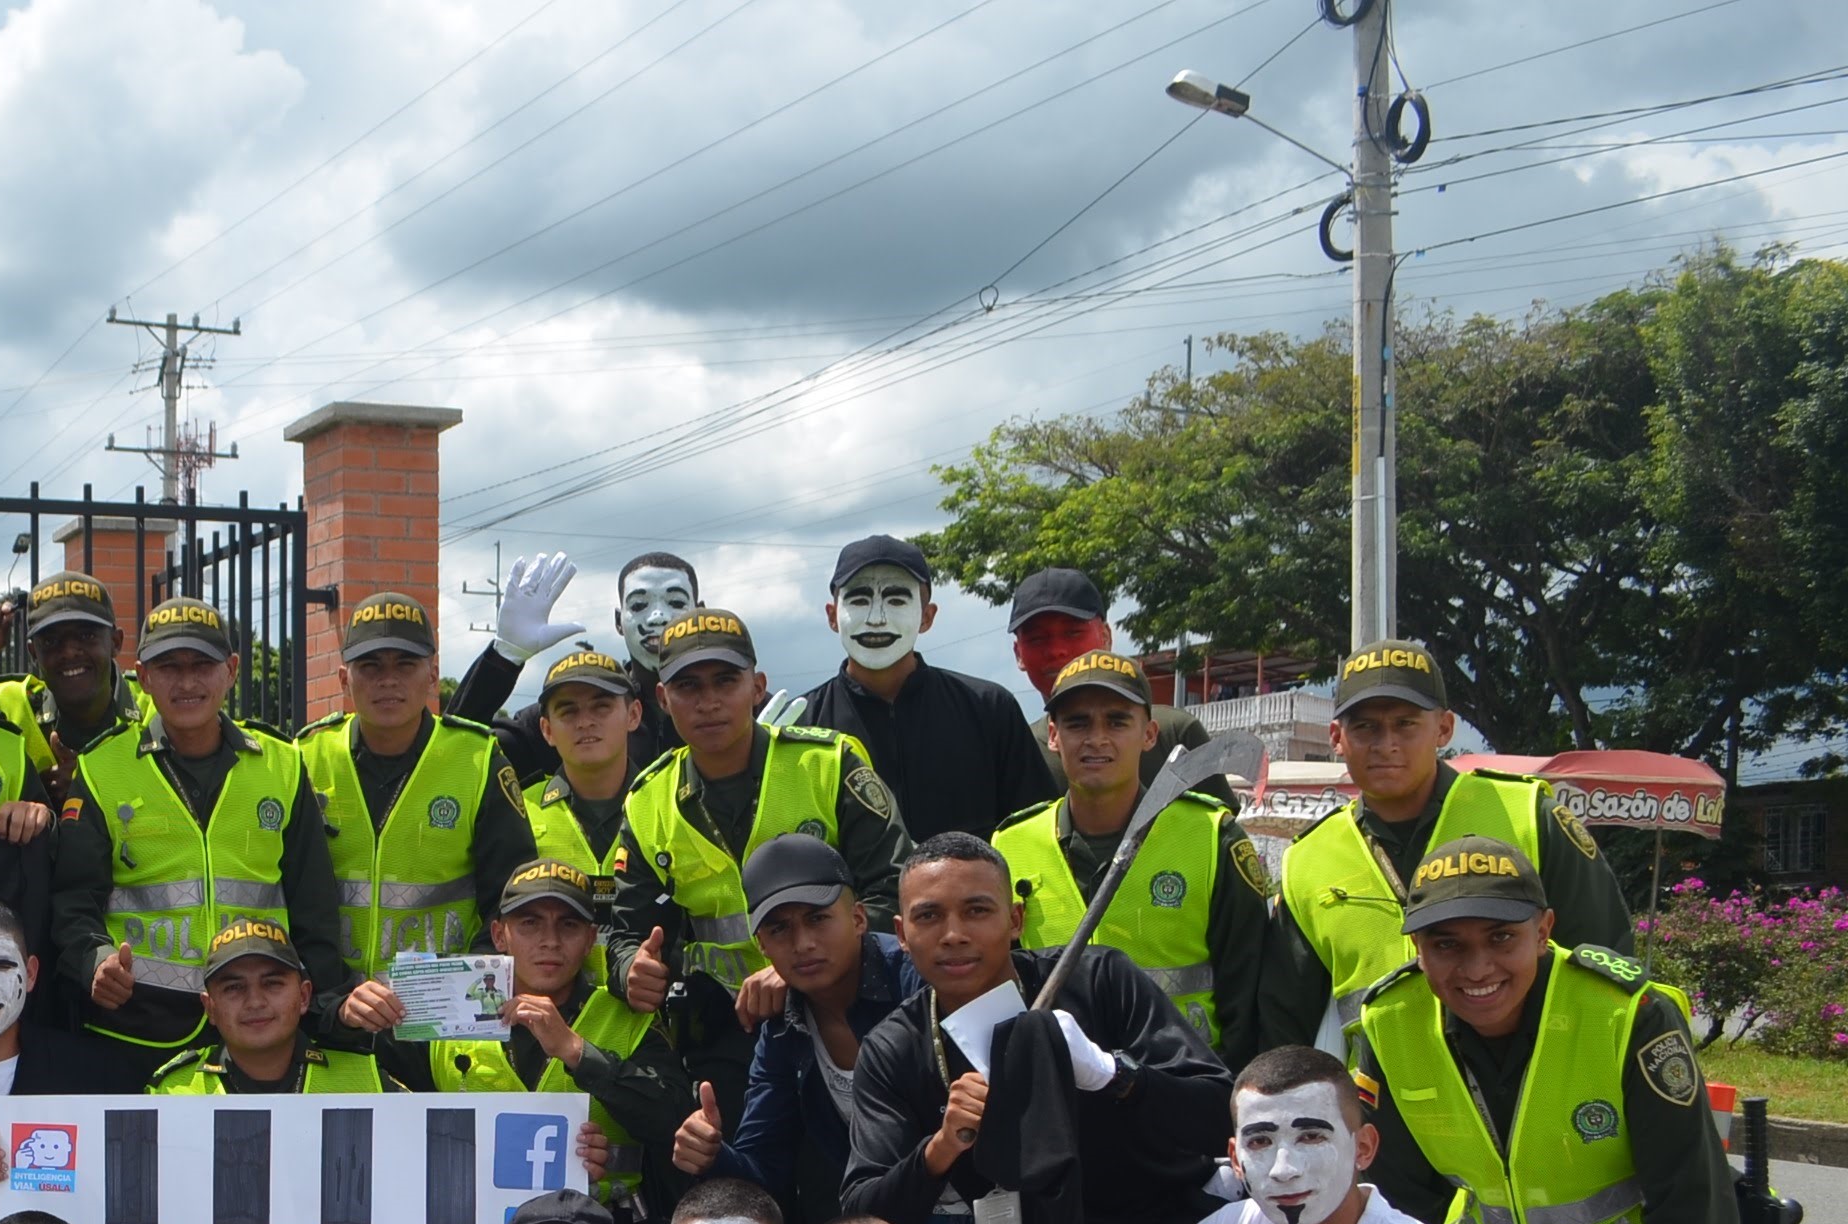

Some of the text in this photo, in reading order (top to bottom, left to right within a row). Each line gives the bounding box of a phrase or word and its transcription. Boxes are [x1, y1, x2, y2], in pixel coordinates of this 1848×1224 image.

[31, 579, 102, 608] POLICIA
[149, 606, 221, 631] POLICIA
[353, 602, 424, 626] POLICIA
[662, 616, 743, 645] POLICIA
[549, 650, 617, 679] POLICIA
[1054, 653, 1138, 688] POLICIA
[1342, 648, 1432, 680] POLICIA
[1557, 789, 1586, 818] La
[1587, 788, 1659, 821] Sazón
[1660, 791, 1692, 823] de
[512, 864, 589, 891] POLICIA
[1414, 852, 1520, 888] POLICIA
[212, 922, 289, 952] POLICIA
[1647, 1045, 1688, 1073] NACIONAL
[1650, 1037, 1678, 1057] POLICIA
[14, 1172, 72, 1182] INTELIGENCIA
[14, 1181, 35, 1191] VIAL
